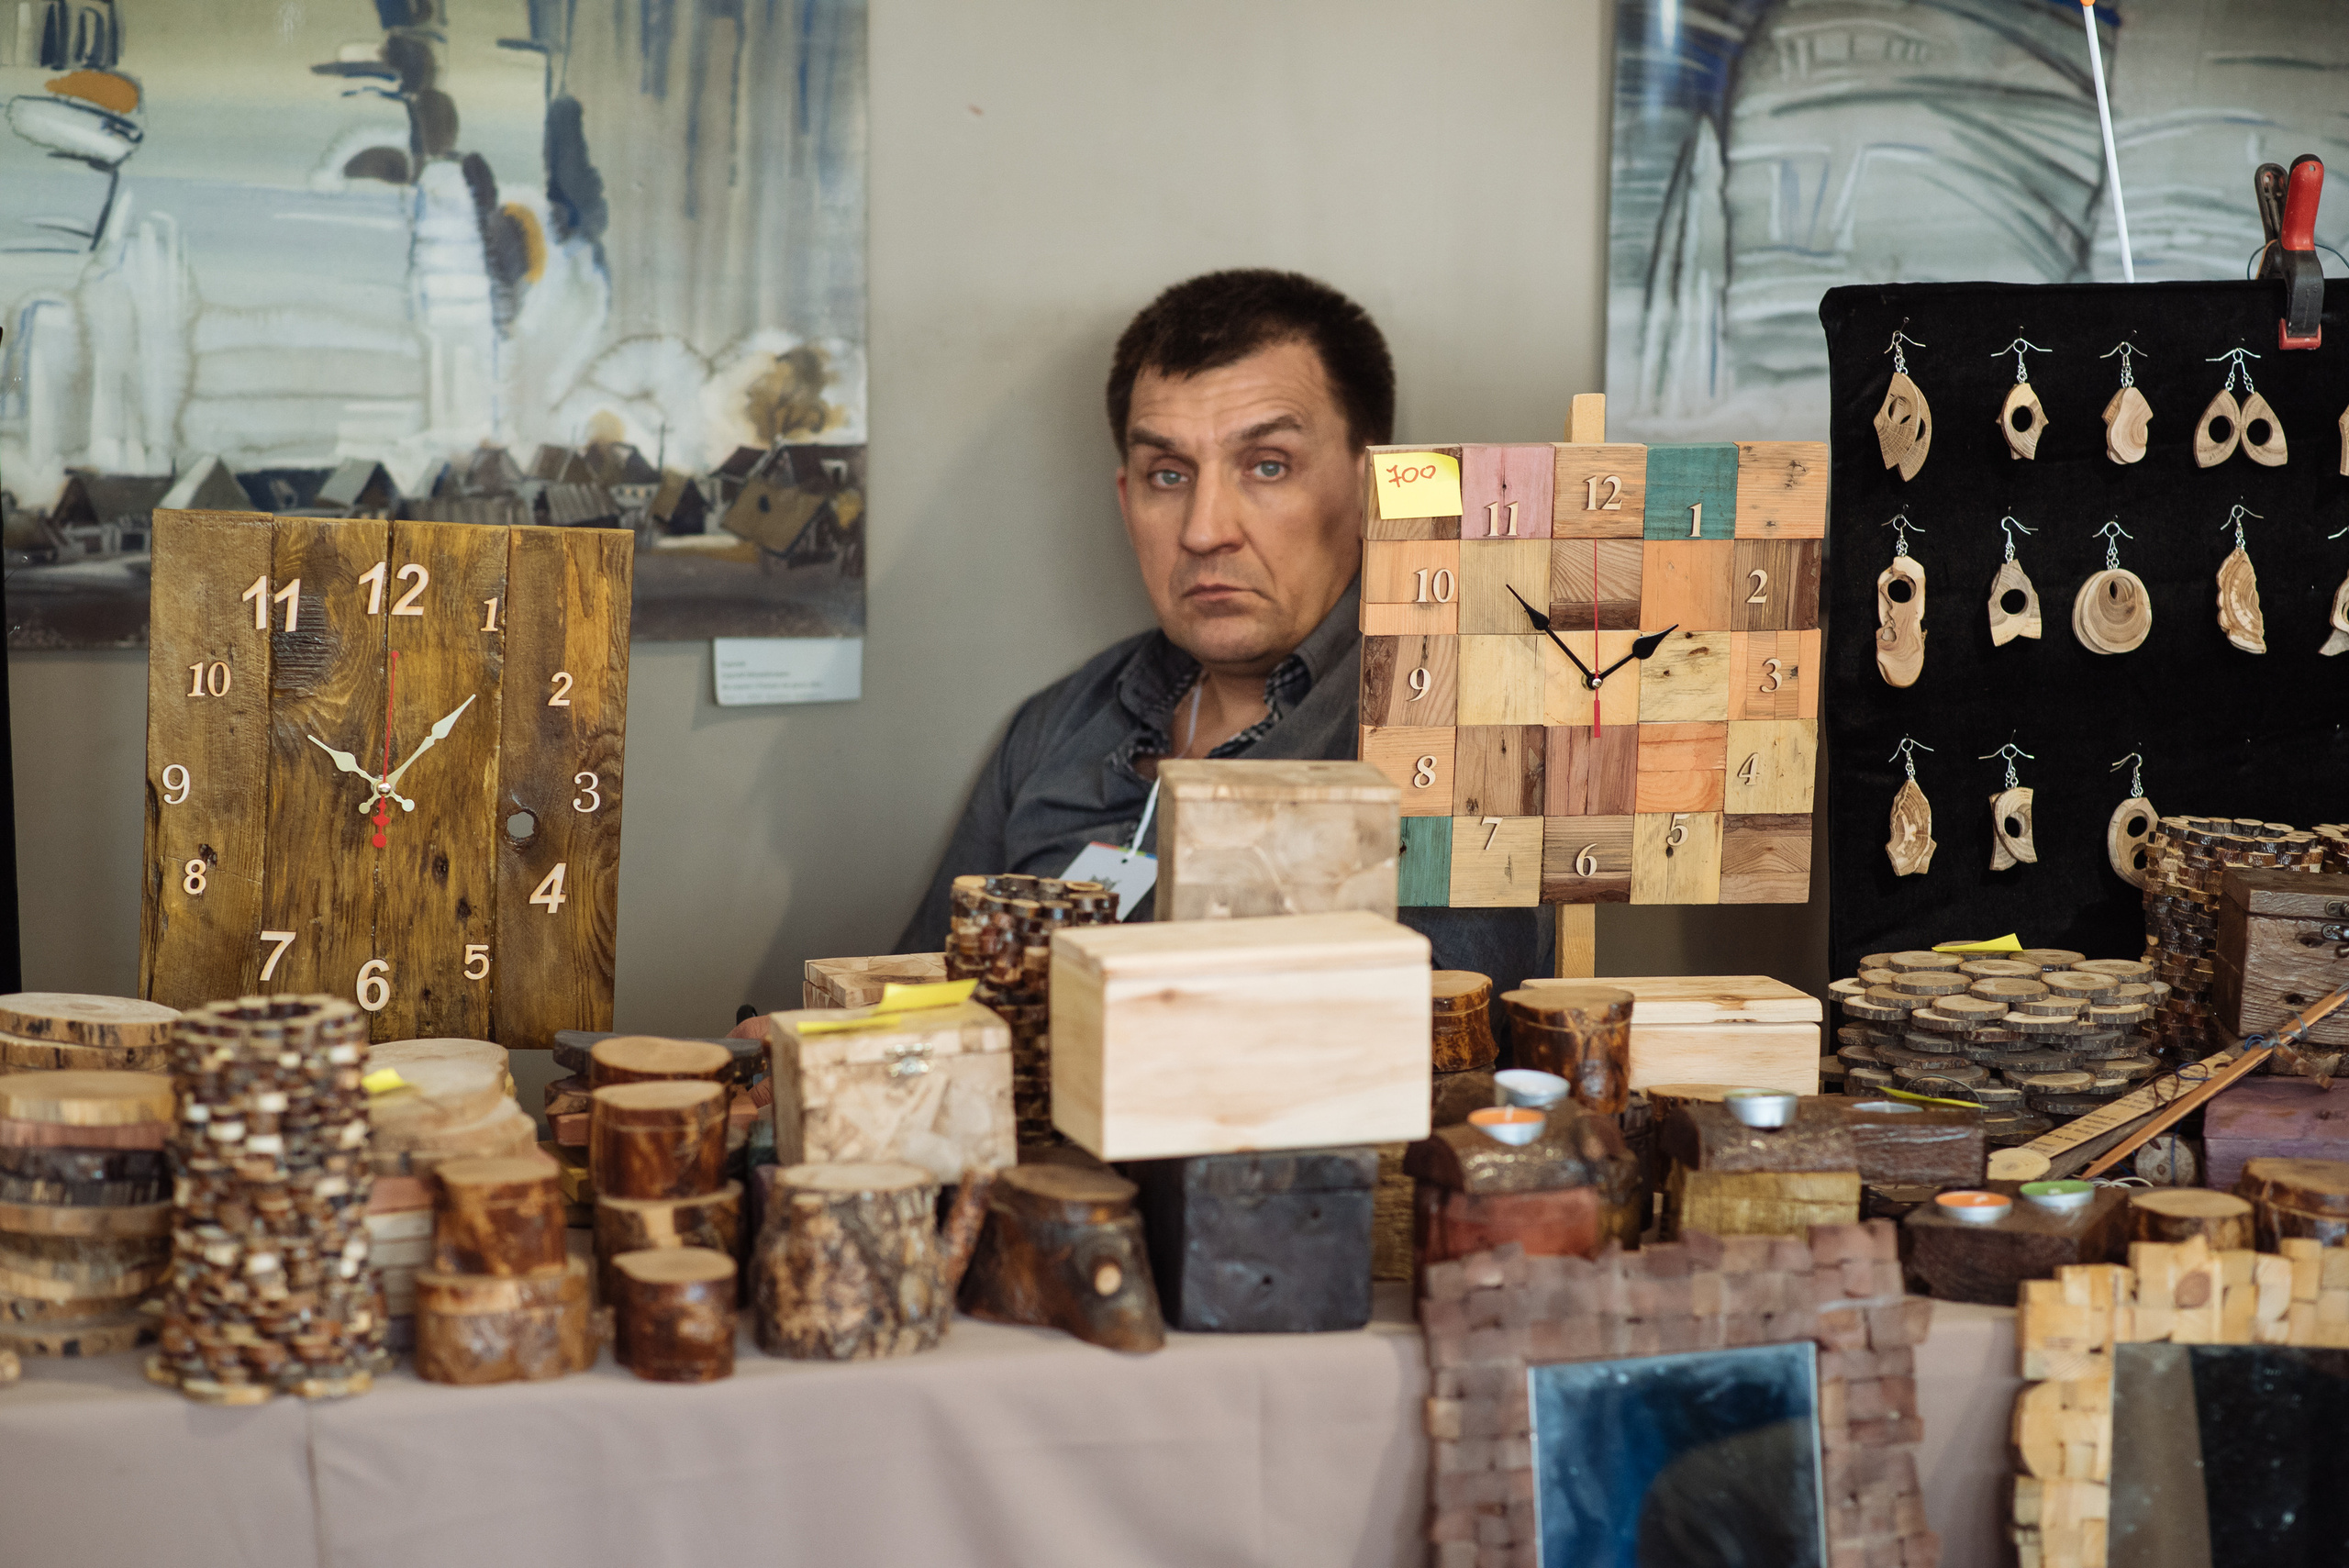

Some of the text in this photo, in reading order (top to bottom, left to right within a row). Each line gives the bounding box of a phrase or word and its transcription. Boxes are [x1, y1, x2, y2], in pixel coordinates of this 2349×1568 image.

[1386, 464, 1436, 487] 700
[1584, 475, 1623, 511] 12
[1484, 501, 1520, 537] 11
[1687, 503, 1702, 538] 1
[241, 575, 301, 633] 11
[358, 561, 429, 616] 12
[1413, 568, 1456, 604] 10
[1745, 569, 1769, 604] 2
[480, 597, 499, 632] 1
[186, 661, 231, 697] 10
[548, 672, 573, 706] 2
[1406, 667, 1432, 703] 9
[1759, 658, 1784, 693] 3
[161, 764, 191, 805] 9
[1413, 754, 1438, 789] 8
[1737, 752, 1761, 786] 4
[572, 772, 601, 812] 3
[1480, 817, 1504, 851] 7
[1665, 814, 1691, 846] 5
[183, 859, 207, 895] 8
[1575, 843, 1598, 877] 6
[529, 862, 567, 914] 4
[259, 930, 297, 982] 7
[463, 943, 489, 980] 5
[356, 959, 391, 1011] 6
